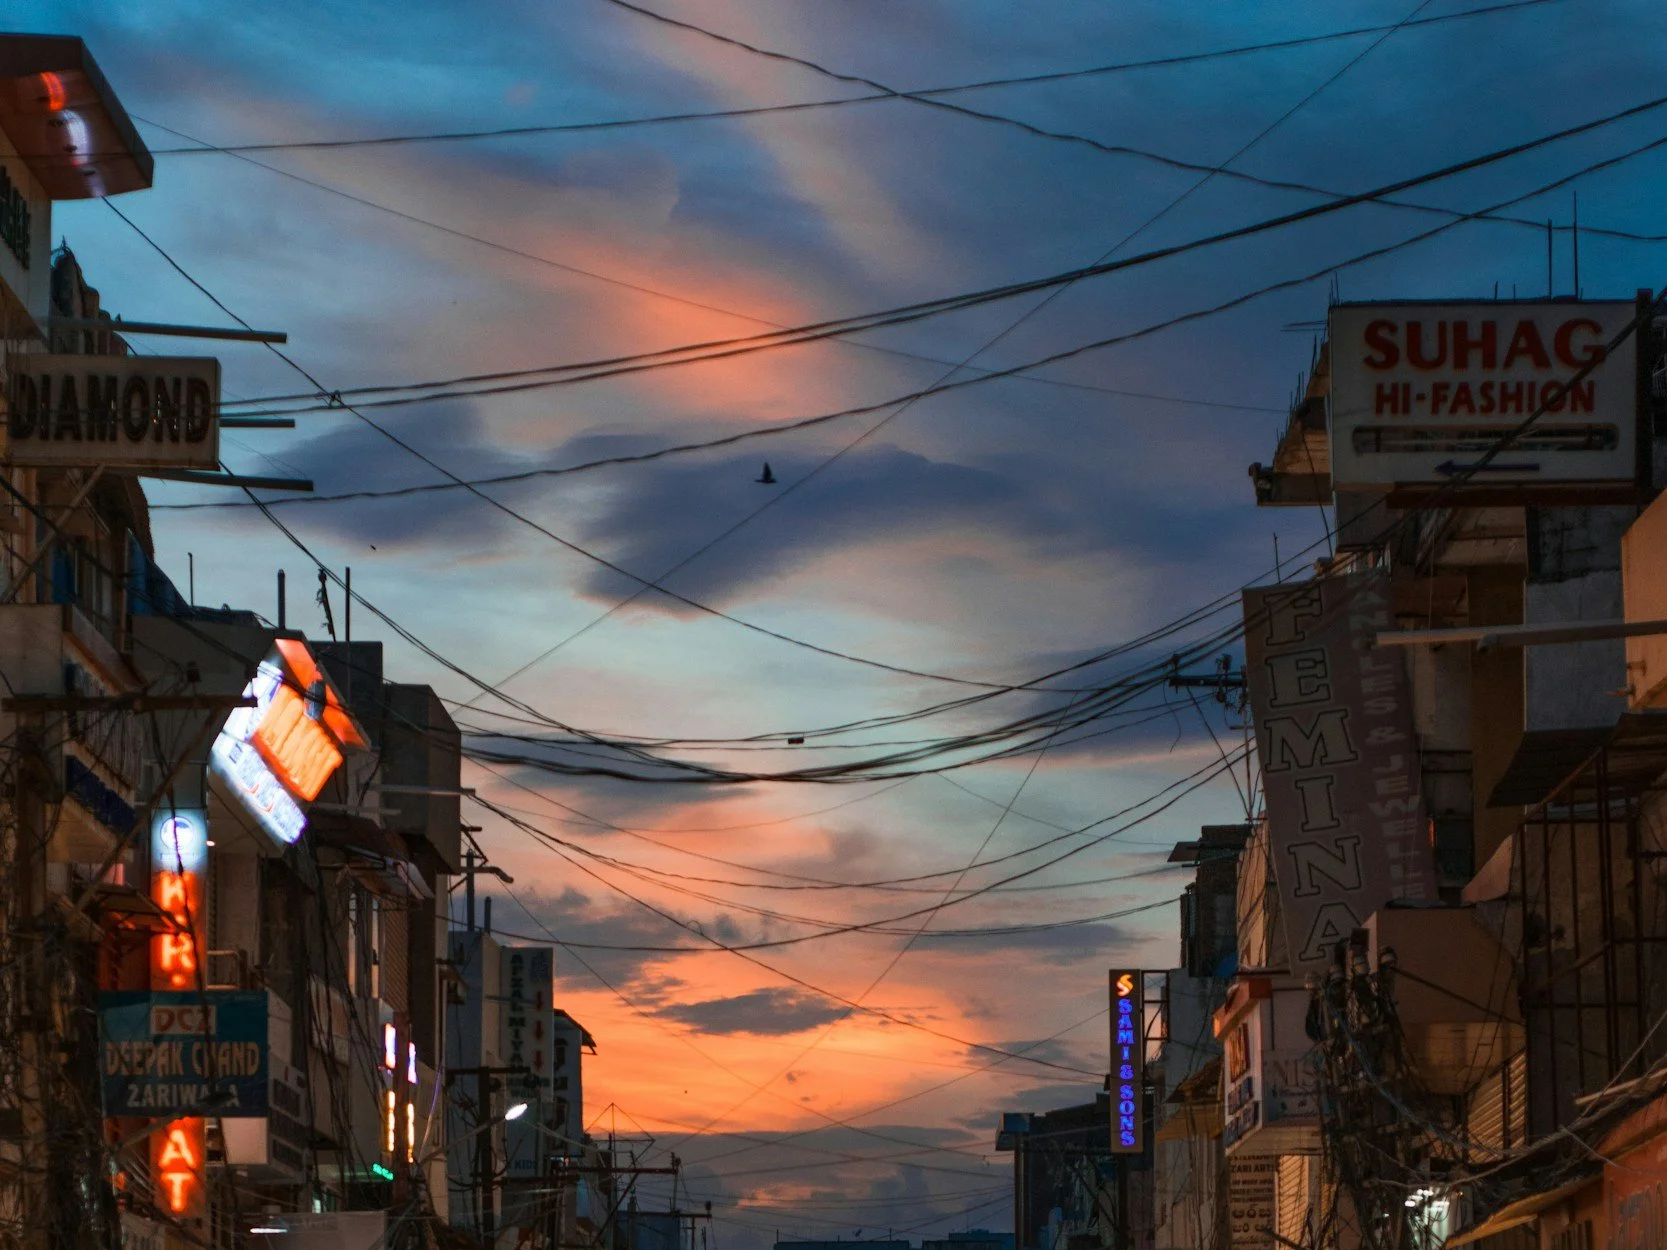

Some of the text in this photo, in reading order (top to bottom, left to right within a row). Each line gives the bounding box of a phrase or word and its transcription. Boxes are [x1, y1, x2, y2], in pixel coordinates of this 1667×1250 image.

[1363, 318, 1606, 371] SUHAG
[8, 373, 211, 443] DIAMOND
[1375, 380, 1595, 416] HI-FASHION
[104, 1040, 185, 1077] DEEPAK
[1119, 1084, 1136, 1147] SONS
